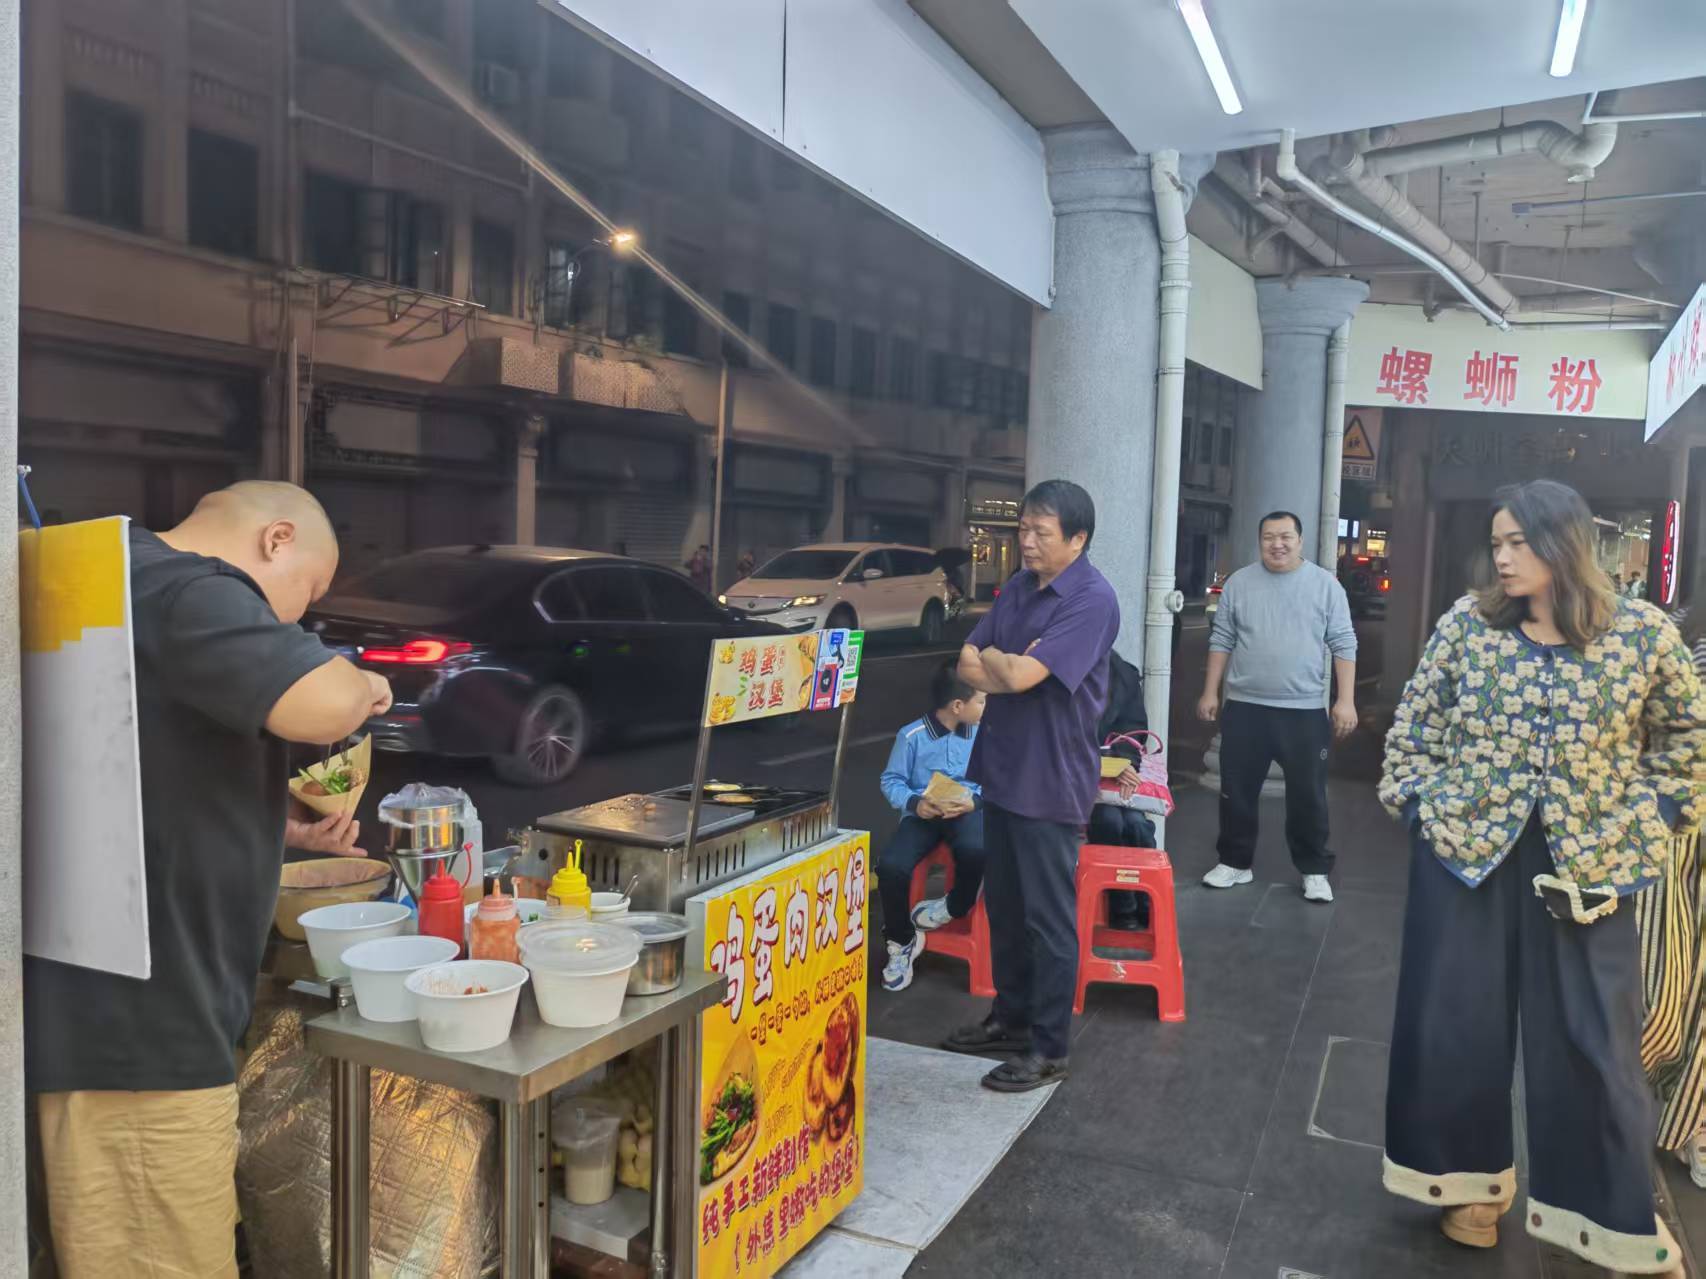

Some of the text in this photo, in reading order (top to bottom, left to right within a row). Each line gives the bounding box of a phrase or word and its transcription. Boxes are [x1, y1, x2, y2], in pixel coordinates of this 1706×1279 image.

[1376, 347, 1602, 413] 螺蛳粉
[738, 644, 777, 677] 鸡蛋
[748, 679, 785, 711] 汉堡
[710, 847, 865, 1023] 鸡蛋肉汉堡
[702, 1123, 810, 1245] 纯手工新鲜制作
